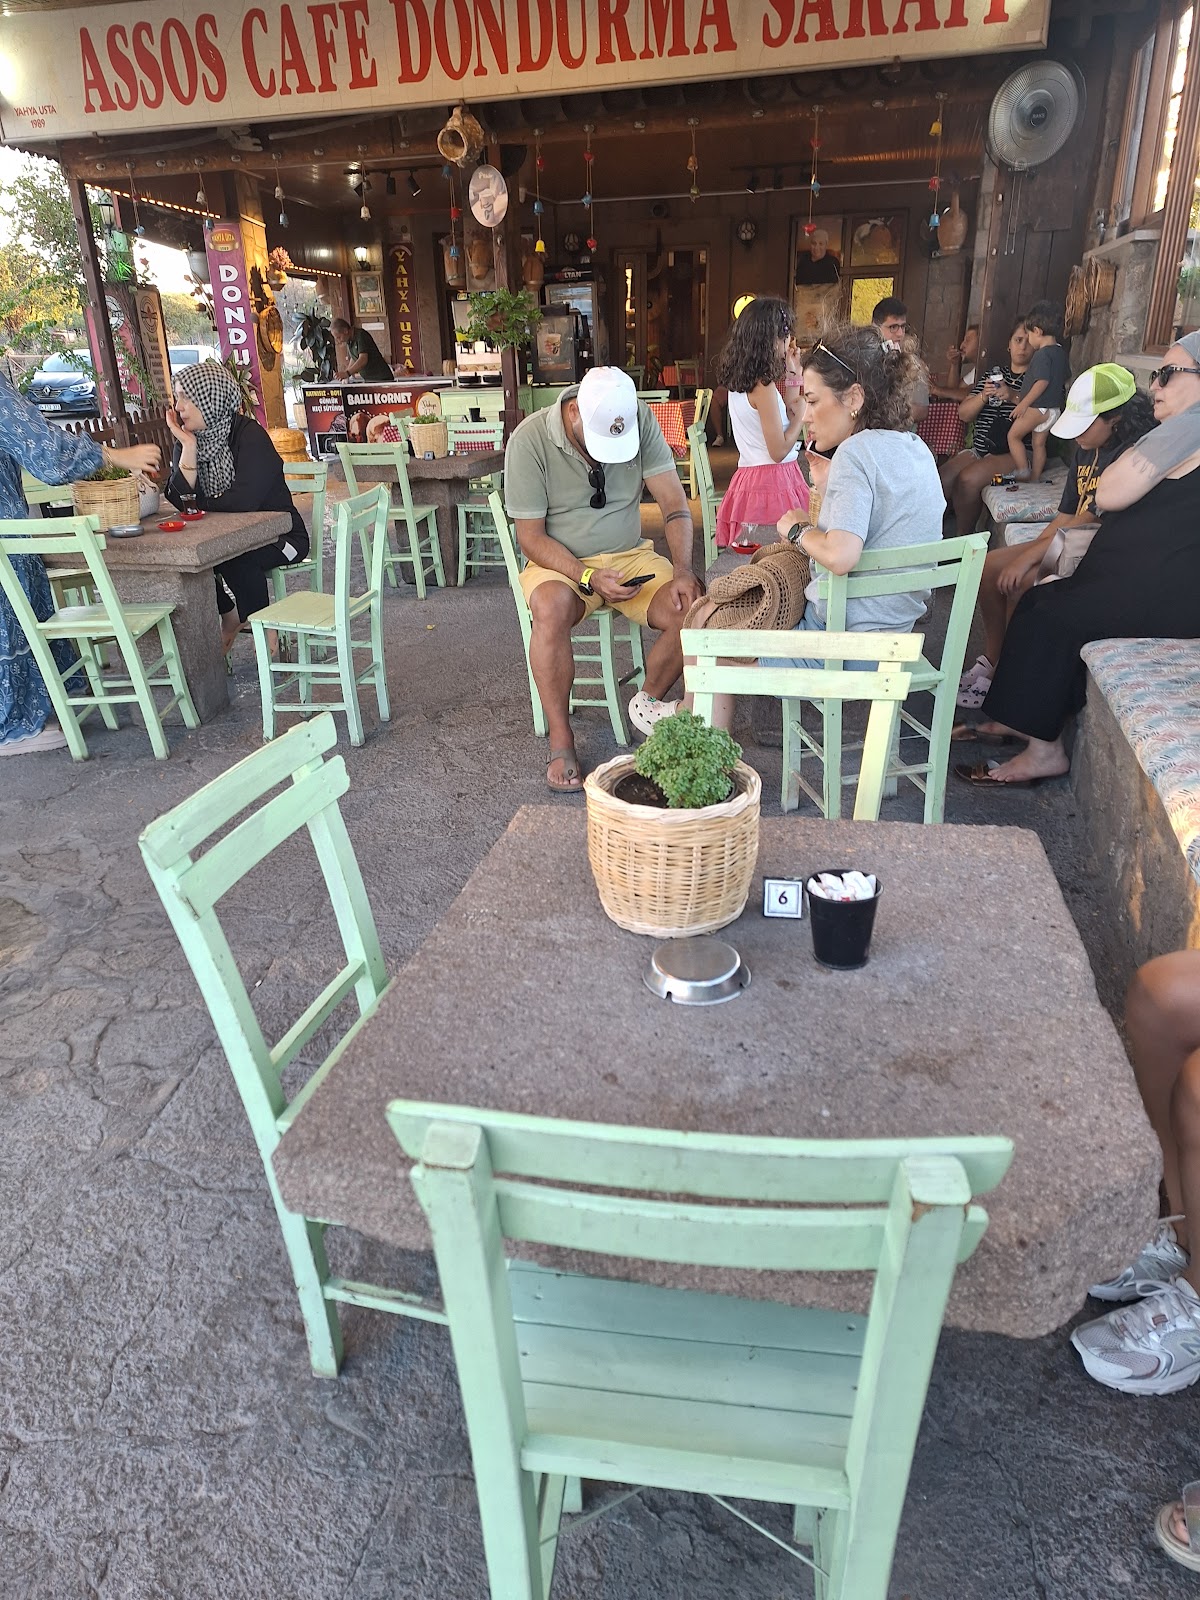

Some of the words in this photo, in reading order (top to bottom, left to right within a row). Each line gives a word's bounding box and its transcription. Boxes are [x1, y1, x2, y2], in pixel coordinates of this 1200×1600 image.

[80, 13, 228, 113] ASSOS
[242, 0, 378, 98] CAFE
[397, 0, 738, 84] DONDURMA
[14, 106, 38, 117] YAHYA
[38, 105, 57, 115] USTA
[31, 119, 46, 129] 1989
[395, 251, 411, 313] YAHYA
[219, 264, 261, 424] DONDU
[399, 321, 415, 369] USTA
[347, 393, 373, 405] BALLI
[374, 392, 412, 405] KORNET
[778, 890, 788, 905] 6
